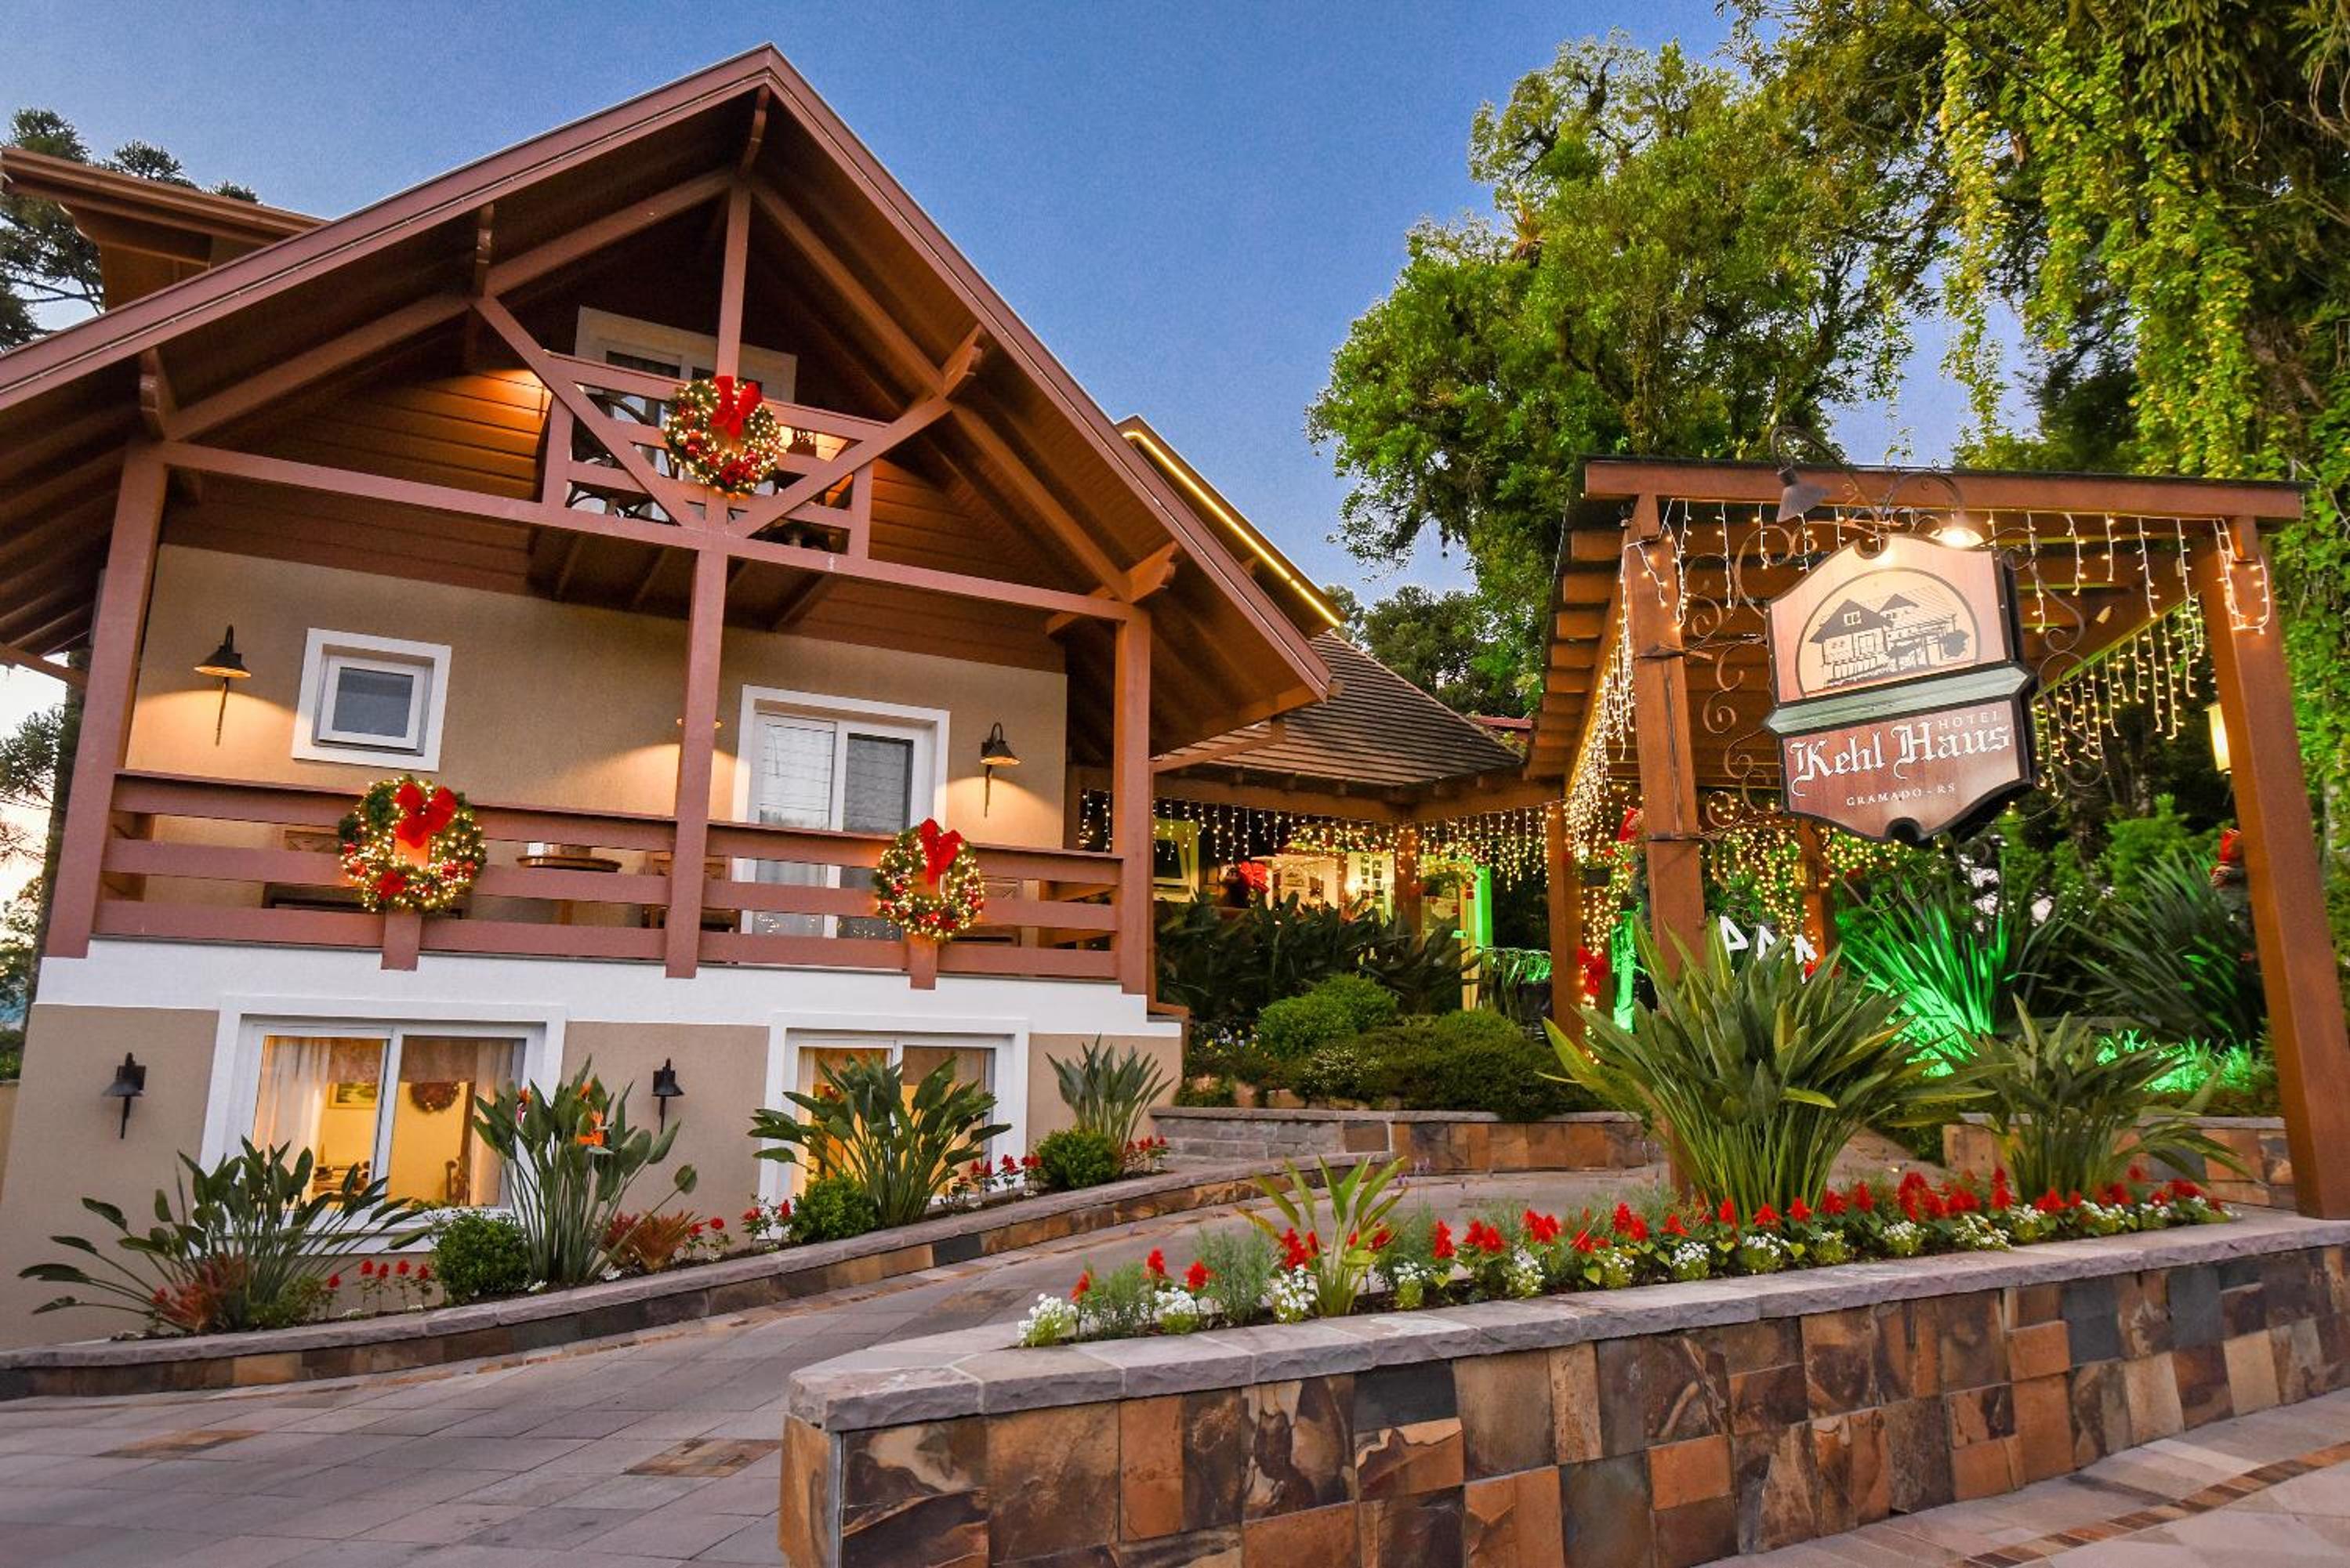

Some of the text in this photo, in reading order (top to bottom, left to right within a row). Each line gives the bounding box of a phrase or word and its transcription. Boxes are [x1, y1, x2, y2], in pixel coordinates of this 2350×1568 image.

[1938, 710, 2000, 730] HOTEL
[1789, 721, 2011, 797] Kehl Haus
[1845, 787, 1922, 806] GRAMADO
[1937, 782, 1956, 795] RS
